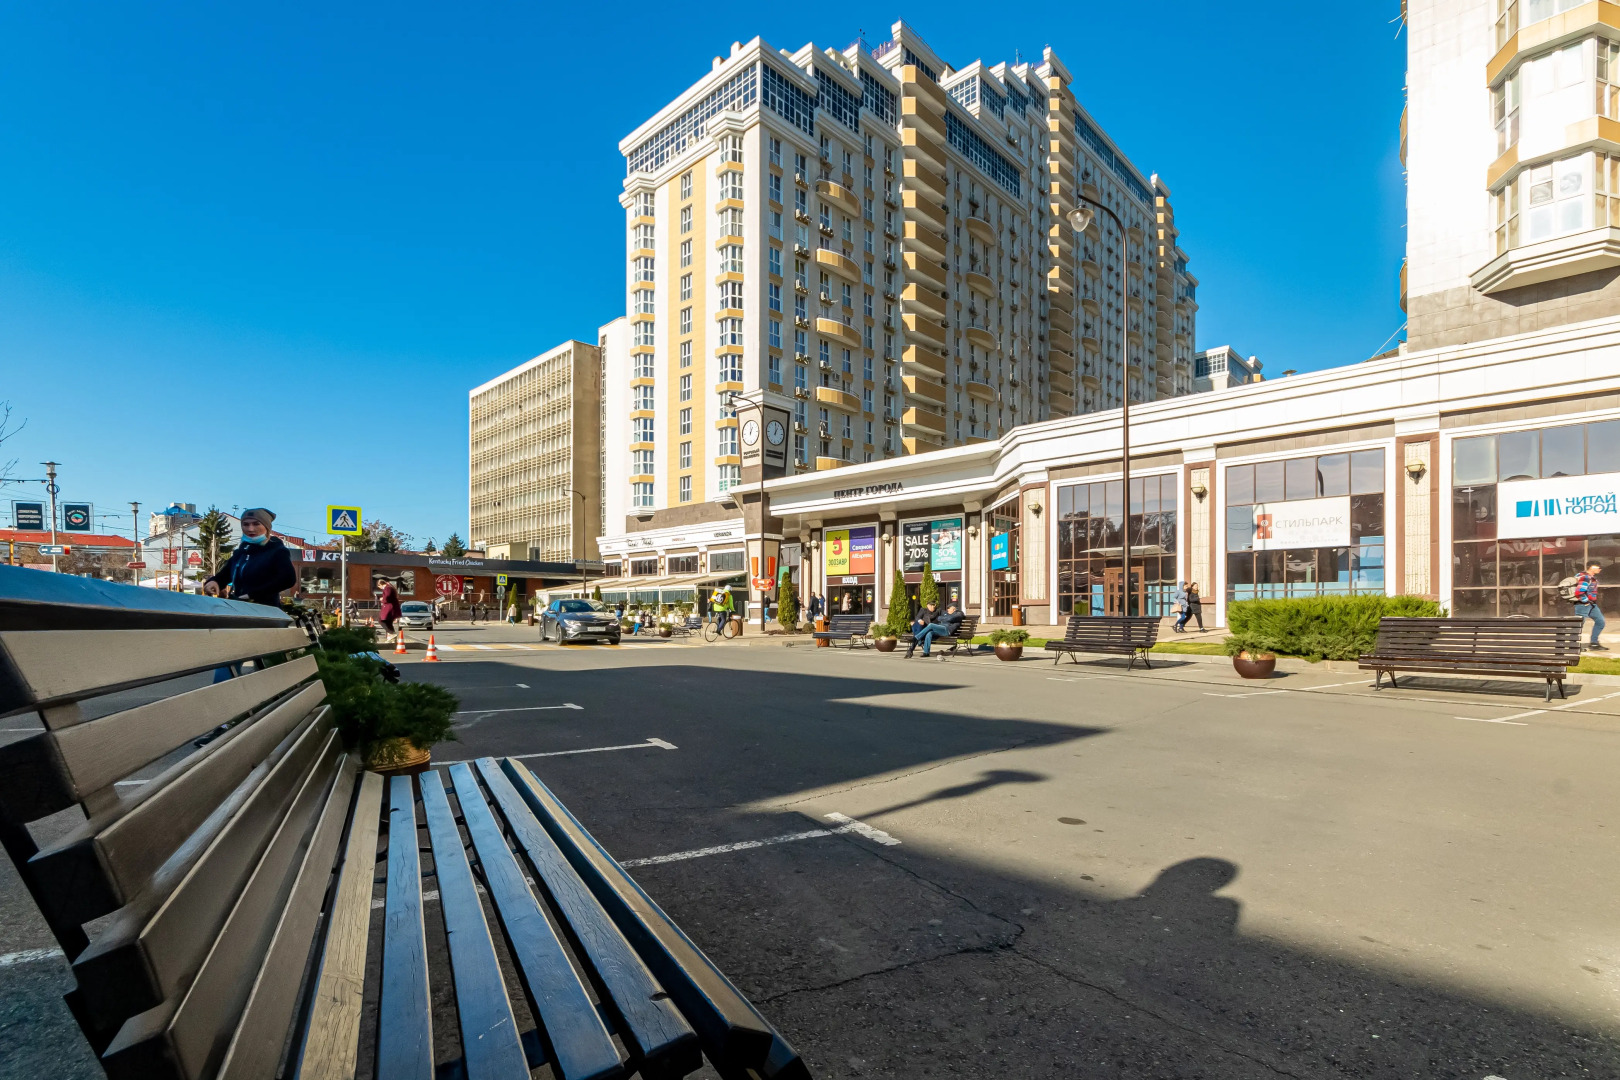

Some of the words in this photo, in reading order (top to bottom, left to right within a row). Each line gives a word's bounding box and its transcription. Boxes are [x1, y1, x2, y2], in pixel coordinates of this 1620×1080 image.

[833, 487, 864, 500] ЦЕНТР
[865, 481, 904, 496] ГОРОДА
[1565, 491, 1616, 506] ЧИТАЙ
[1565, 502, 1618, 515] ГОРОД
[1275, 516, 1344, 529] СТИЛЬПАРК
[905, 534, 929, 547] SALE
[320, 551, 350, 562] KFC
[428, 557, 452, 566] Kentucky
[451, 558, 465, 566] Fried
[842, 576, 858, 585] ВХОД
